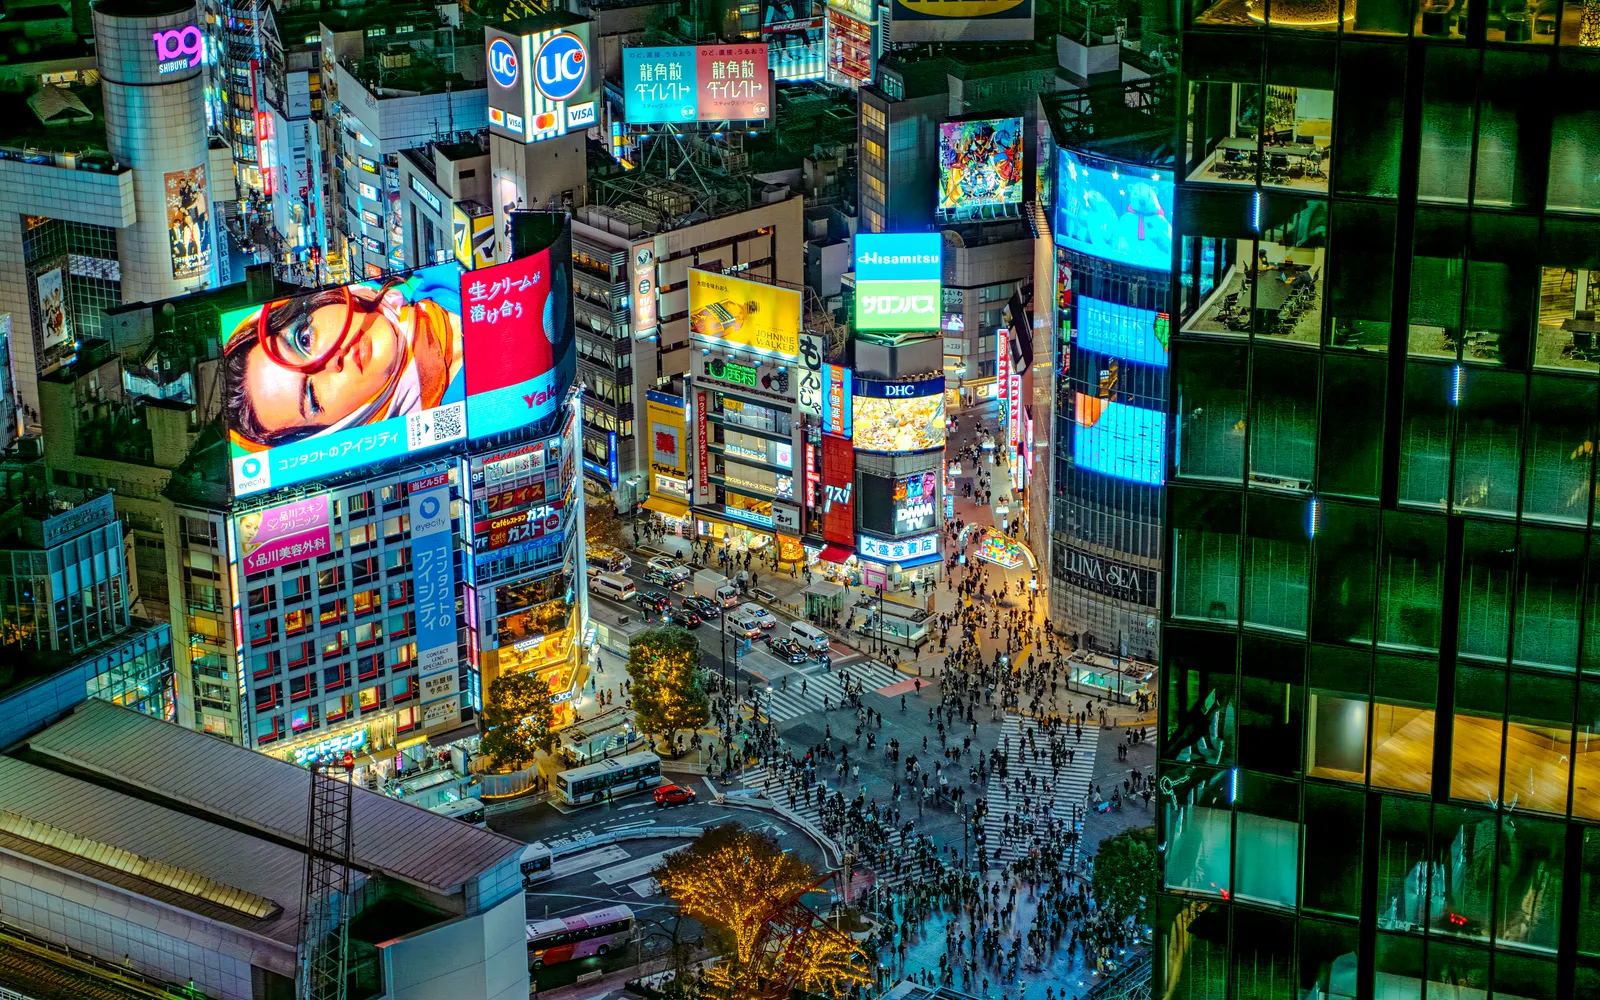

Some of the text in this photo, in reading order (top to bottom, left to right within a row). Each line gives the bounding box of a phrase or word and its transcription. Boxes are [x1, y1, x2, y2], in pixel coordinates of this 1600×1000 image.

[773, 21, 812, 31] SKECHERS
[152, 25, 203, 68] 109
[159, 59, 188, 75] SHIBUYA
[491, 49, 515, 77] UC
[541, 48, 583, 84] UC
[640, 62, 682, 81] 龍角散
[712, 60, 754, 79] 龍角散
[508, 117, 521, 128] VISA
[570, 107, 593, 121] VISA
[857, 251, 939, 265] Hisamitsu
[468, 271, 541, 302] 生クリームが
[469, 299, 523, 325] 溶け合う
[861, 296, 935, 314] サロンパス
[756, 330, 794, 345] JOHNNIE
[756, 338, 795, 352] WALKER
[727, 368, 757, 387] 西村
[799, 335, 822, 414] もんじゃ
[998, 359, 1007, 396] カラオケ
[886, 385, 914, 396] DHC
[1010, 379, 1019, 417] カラオケ
[278, 431, 399, 471] コンタクトのアイシティ
[238, 477, 267, 490] eyecity
[412, 475, 445, 491] 当ビル5F
[472, 472, 484, 482] 9F
[824, 481, 852, 513] クスリ
[279, 502, 324, 522] 品川スキン
[527, 505, 554, 522] ガスト
[897, 502, 933, 522] DMM
[280, 514, 319, 532] クリニック
[415, 517, 446, 532] eyecity
[507, 522, 541, 543] ガスト
[907, 517, 923, 530] TV
[256, 536, 326, 567] 品川美容外科
[475, 536, 488, 548] 7F
[865, 539, 932, 557] 大盛堂書店
[1063, 549, 1142, 592] LUNA SEA
[417, 549, 436, 630] アイシティ
[436, 546, 450, 627] コンタクトの
[426, 648, 449, 659] CONTACT
[423, 657, 453, 670] SPECIALISTS
[294, 730, 367, 766] サンドラッグ
